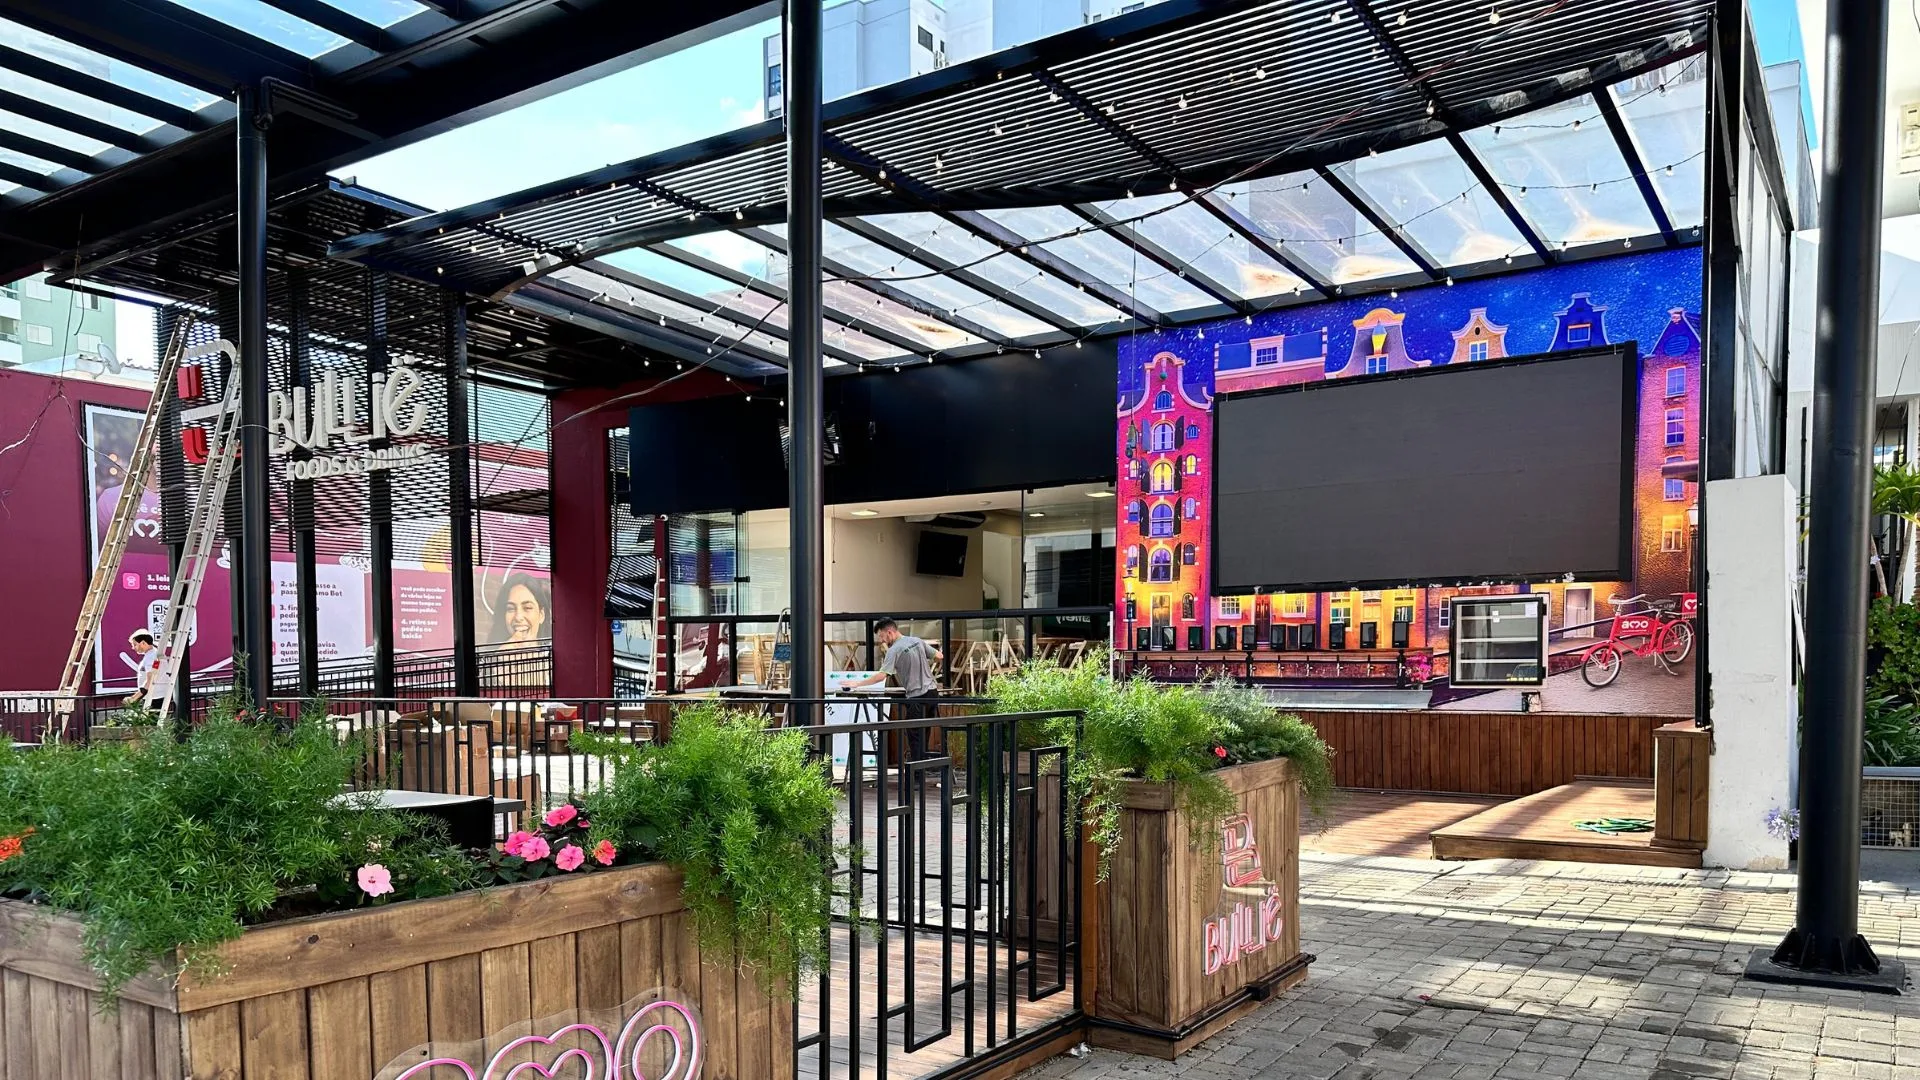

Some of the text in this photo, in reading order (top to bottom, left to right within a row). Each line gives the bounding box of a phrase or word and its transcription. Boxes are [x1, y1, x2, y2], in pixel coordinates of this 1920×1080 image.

[286, 442, 432, 480] FOODS & DRINKS
